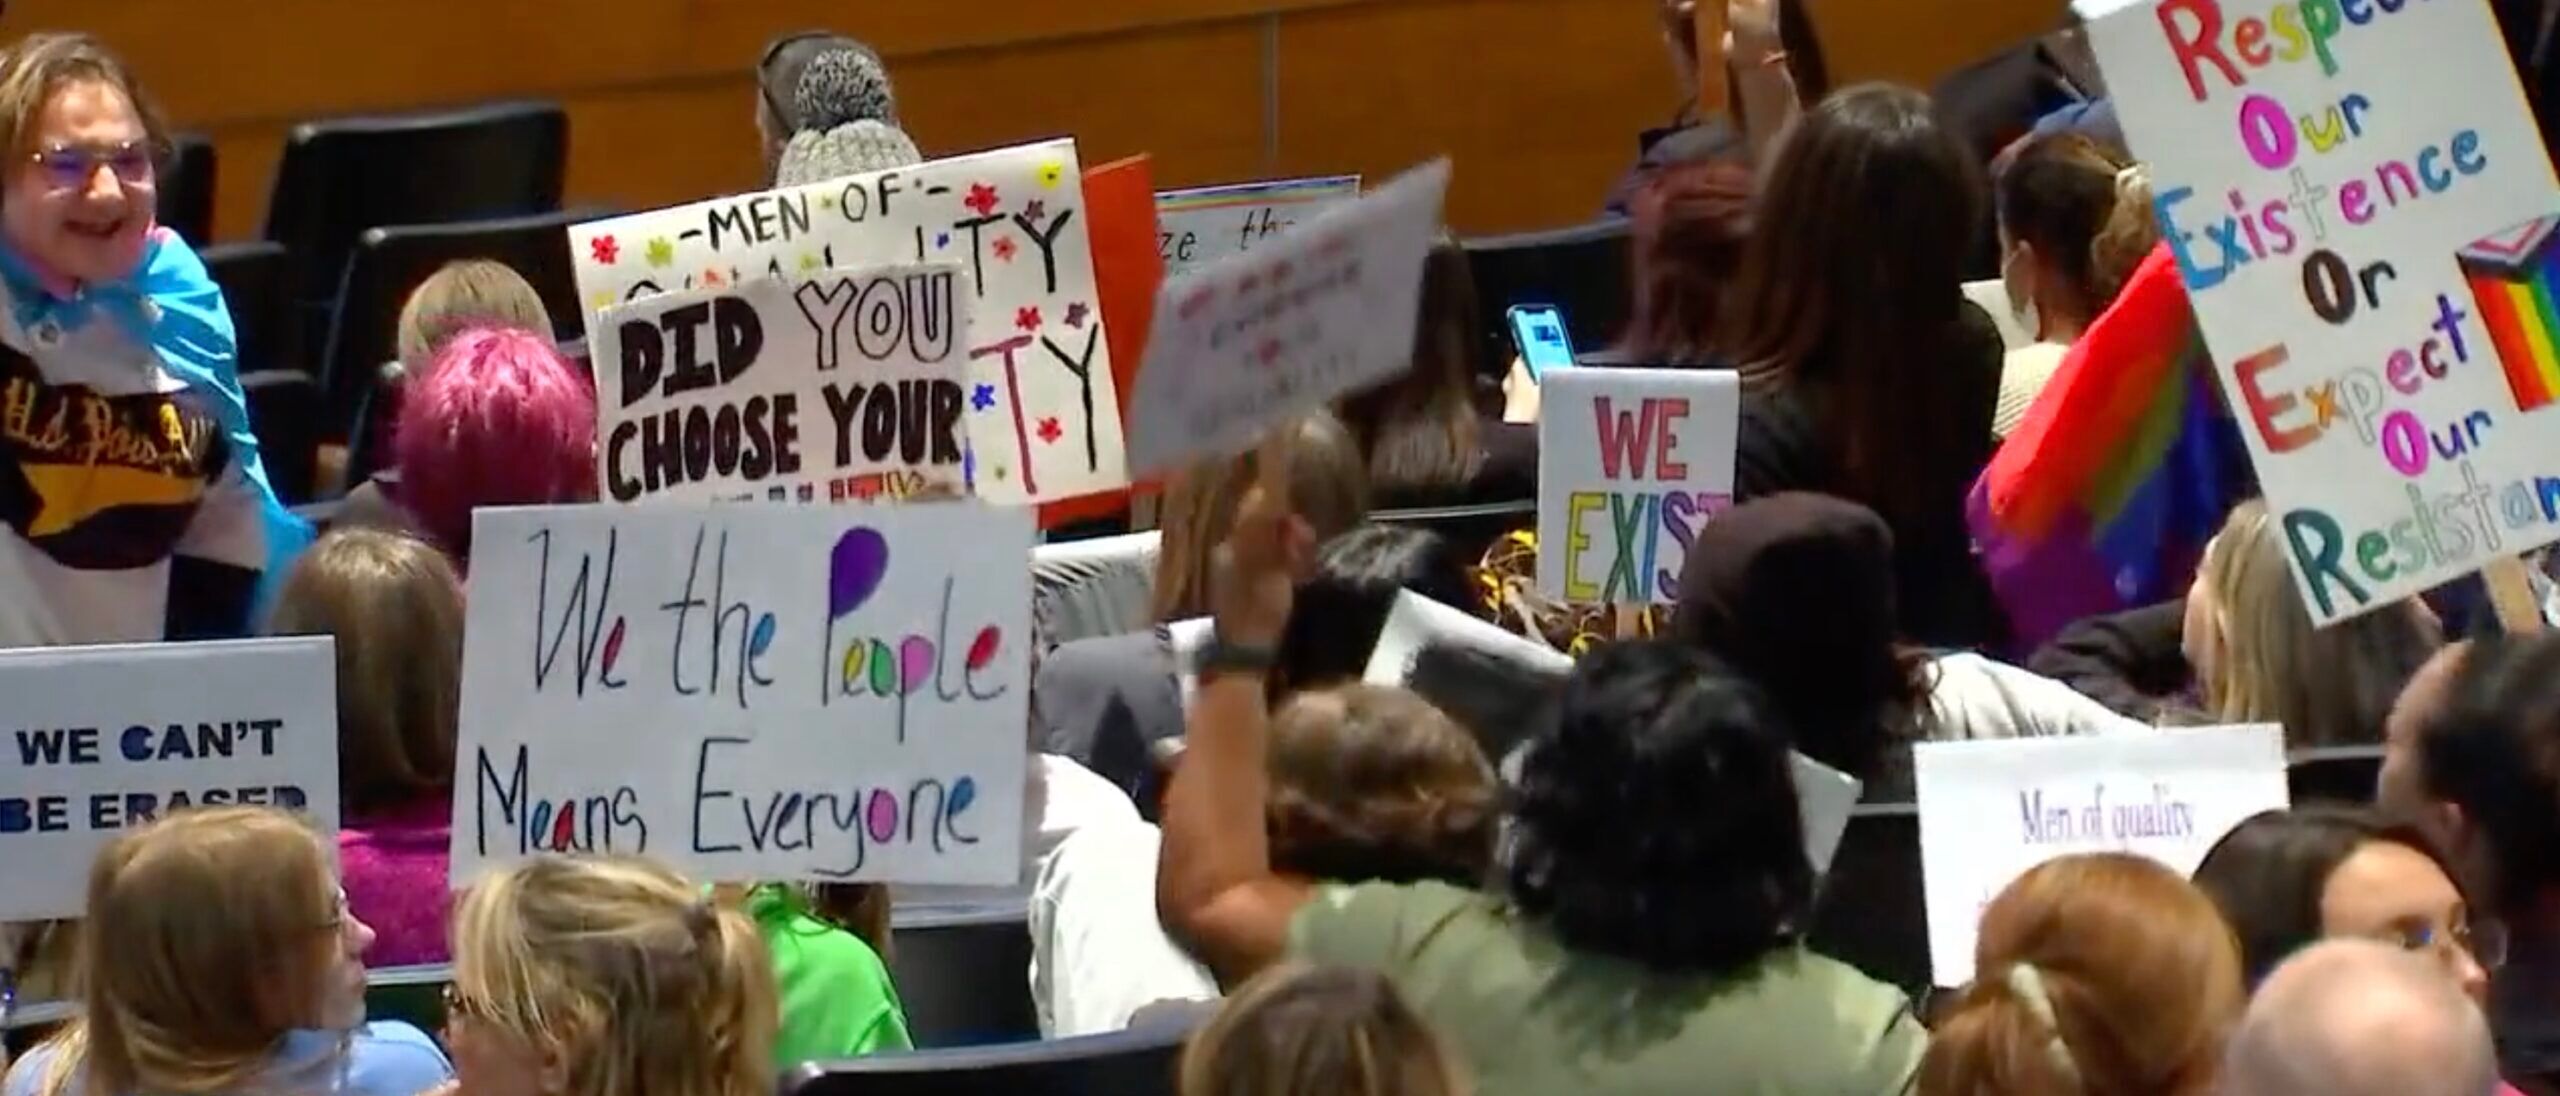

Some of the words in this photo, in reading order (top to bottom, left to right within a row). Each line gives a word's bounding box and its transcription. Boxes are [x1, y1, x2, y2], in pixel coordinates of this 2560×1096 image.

[2239, 93, 2370, 170] Our
[2155, 128, 2486, 291] Existence
[2303, 249, 2396, 325] Or
[619, 296, 764, 408] DID
[794, 271, 954, 371] YOU
[2233, 293, 2467, 454] Expect
[606, 394, 801, 502] CHOOSE
[822, 378, 964, 466] YOUR
[1594, 396, 1690, 480] WE
[2382, 409, 2492, 477] Our
[2282, 461, 2560, 616] Resistan
[528, 526, 627, 698] We
[659, 525, 776, 708] the
[820, 525, 1007, 743] People
[16, 728, 99, 766] WE
[120, 719, 283, 761] CAN'T
[0, 796, 69, 833] BE
[477, 742, 647, 856] Means
[692, 737, 978, 877] Everyone
[2020, 789, 2072, 845] Men
[2082, 783, 2105, 838] of
